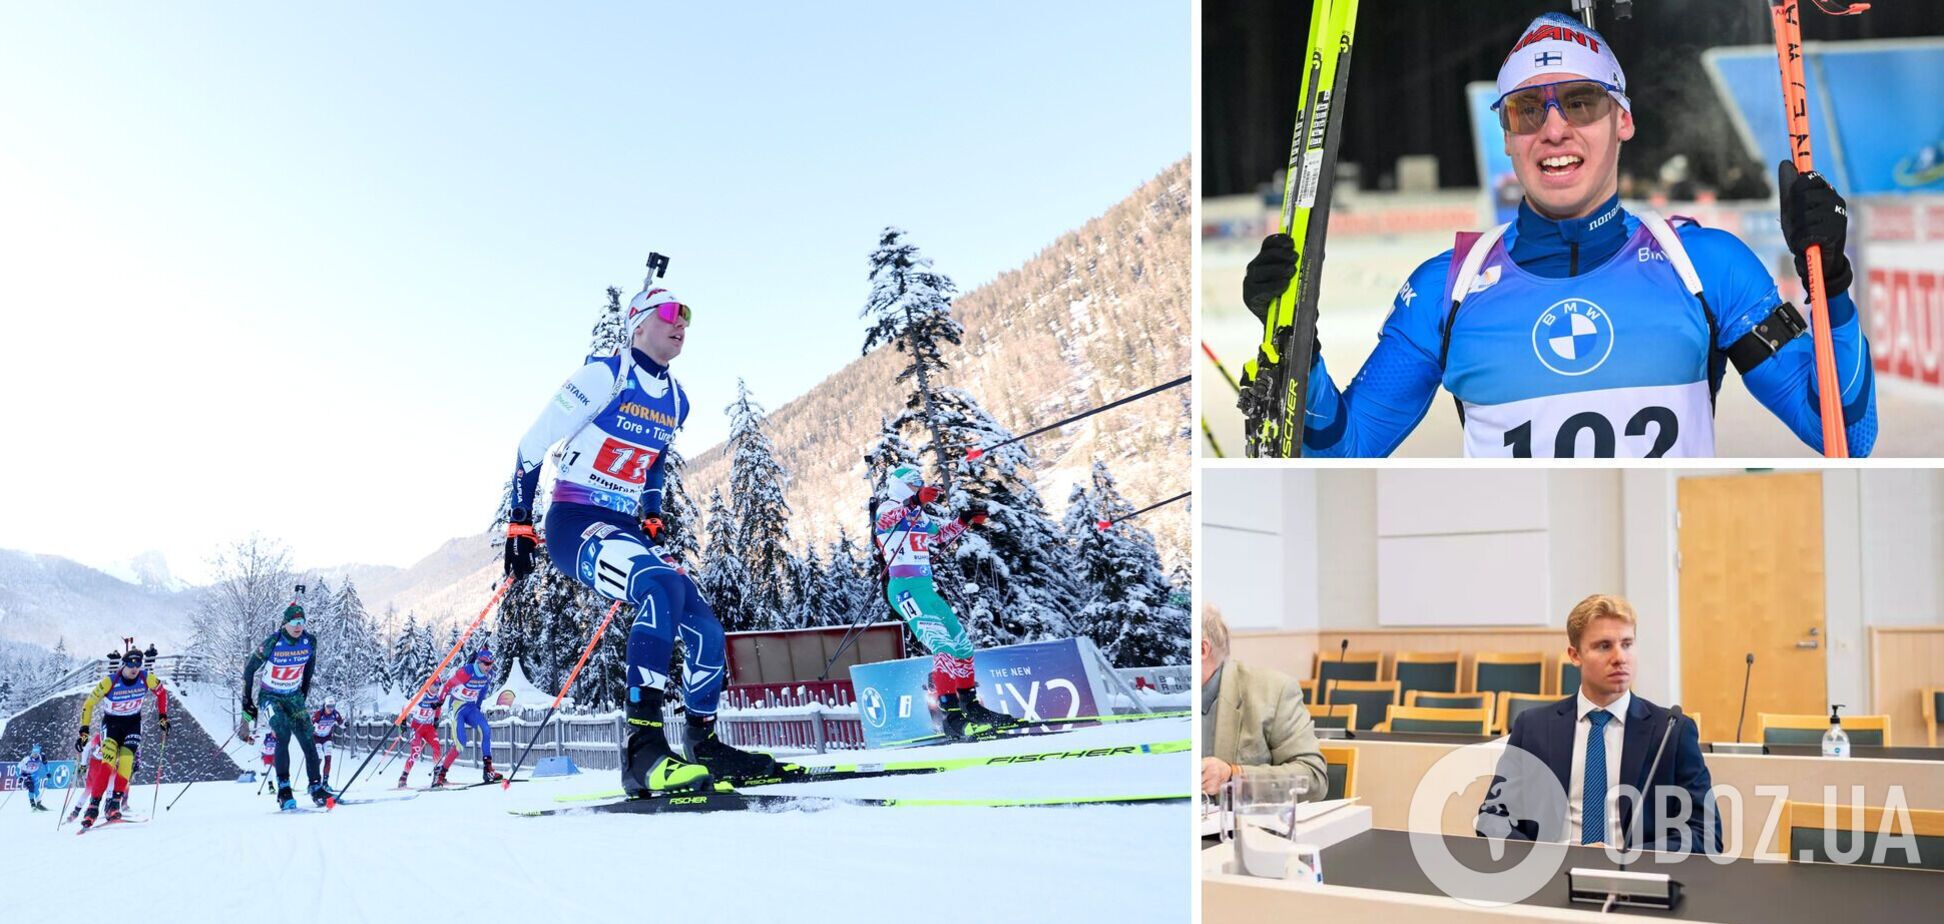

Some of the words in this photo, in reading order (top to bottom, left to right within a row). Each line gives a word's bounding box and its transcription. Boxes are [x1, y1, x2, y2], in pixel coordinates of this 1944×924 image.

[1543, 302, 1601, 326] BMW
[1868, 270, 1944, 385] BAU
[565, 382, 591, 406] STARK
[617, 415, 643, 434] Tore
[619, 402, 676, 428] HÖRMAN
[1281, 378, 1299, 458] ISCHER
[597, 559, 628, 591] 11
[902, 601, 917, 618] 14
[989, 668, 1009, 678] THE
[1011, 666, 1032, 677] NEW
[627, 717, 663, 728] FISCHER
[985, 745, 1136, 767] FISCHER
[743, 776, 783, 787] FISCHER
[668, 795, 708, 805] FISCHER
